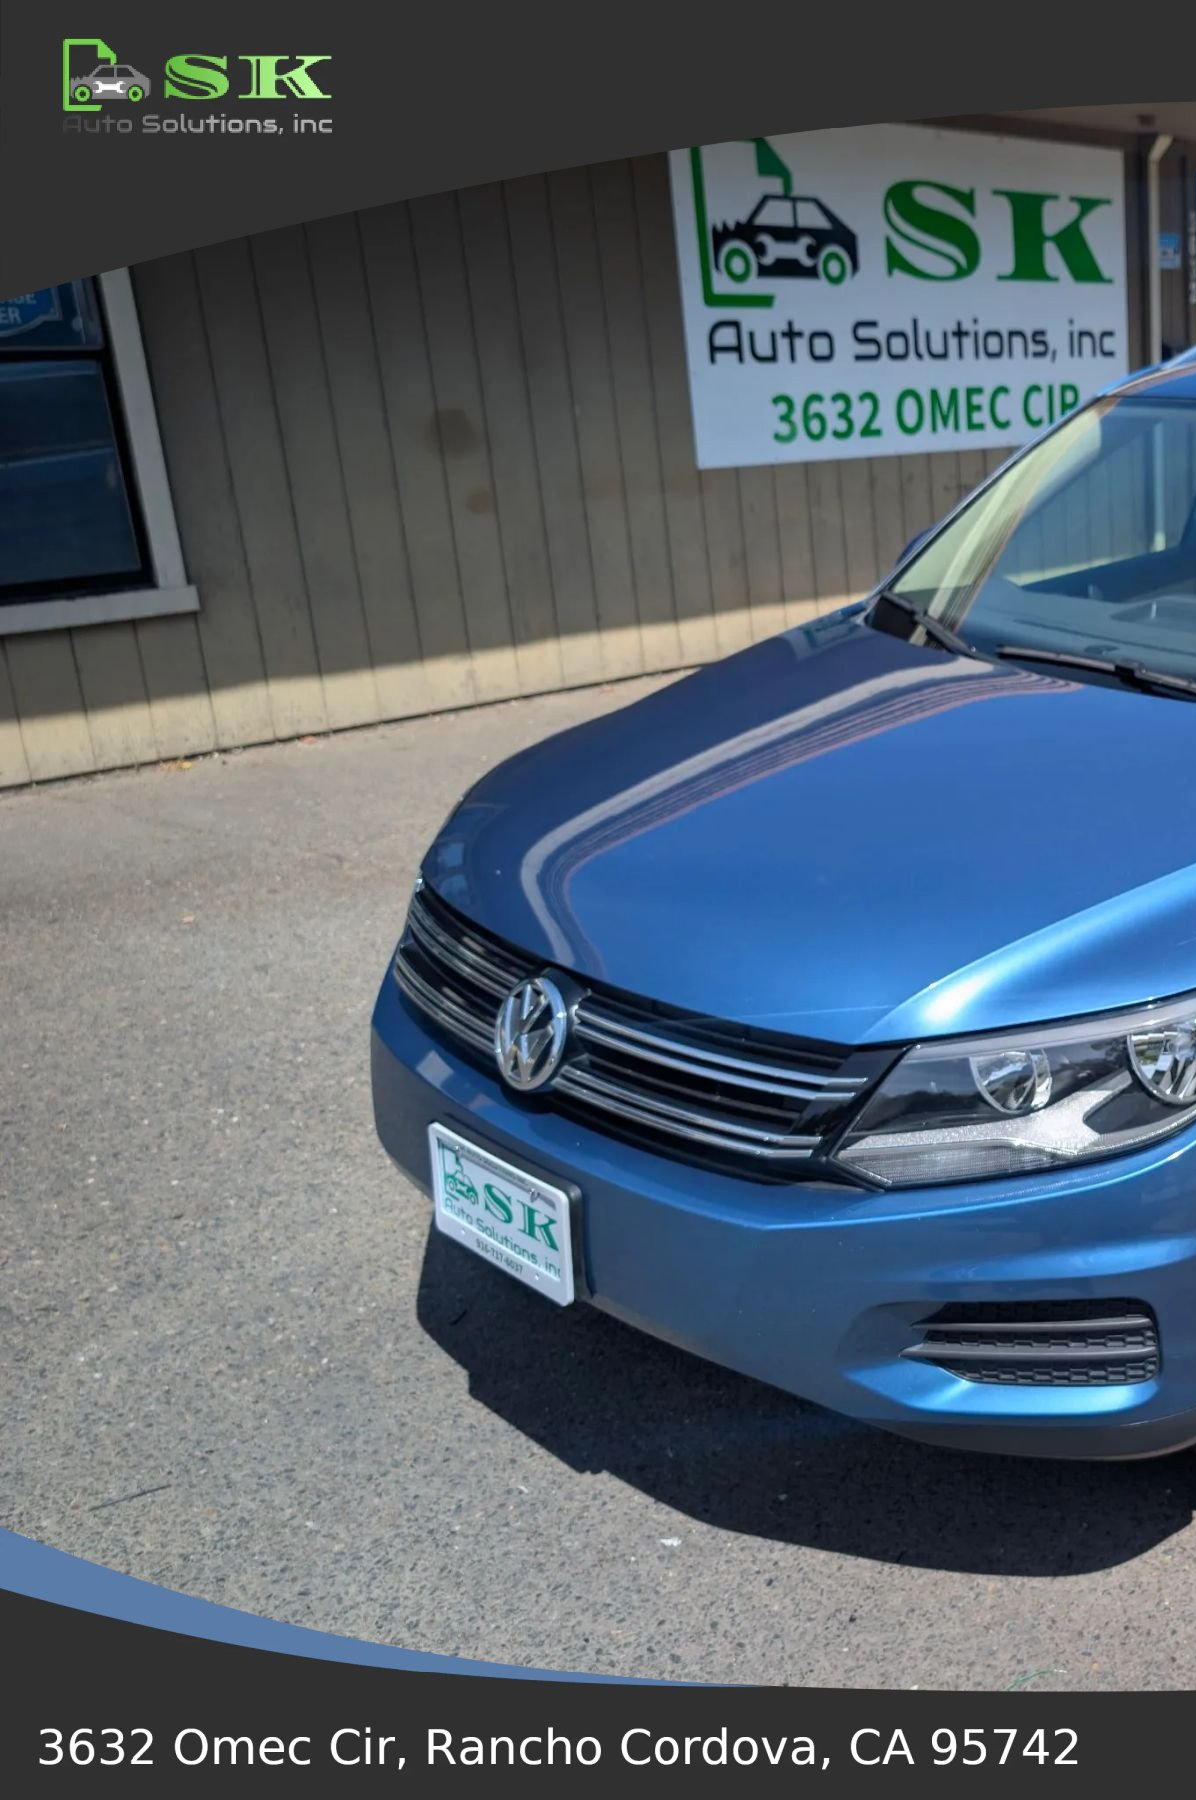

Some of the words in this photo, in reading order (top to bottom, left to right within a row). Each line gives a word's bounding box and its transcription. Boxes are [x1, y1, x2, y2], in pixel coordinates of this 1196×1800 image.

[882, 179, 1114, 284] SK
[707, 319, 836, 365] Auto
[852, 318, 1058, 364] Solutions,
[1068, 318, 1117, 359] inc
[770, 391, 883, 444] 3632
[895, 385, 1012, 434] OMEC
[444, 1198, 474, 1226] Auto
[483, 1183, 561, 1252] SK
